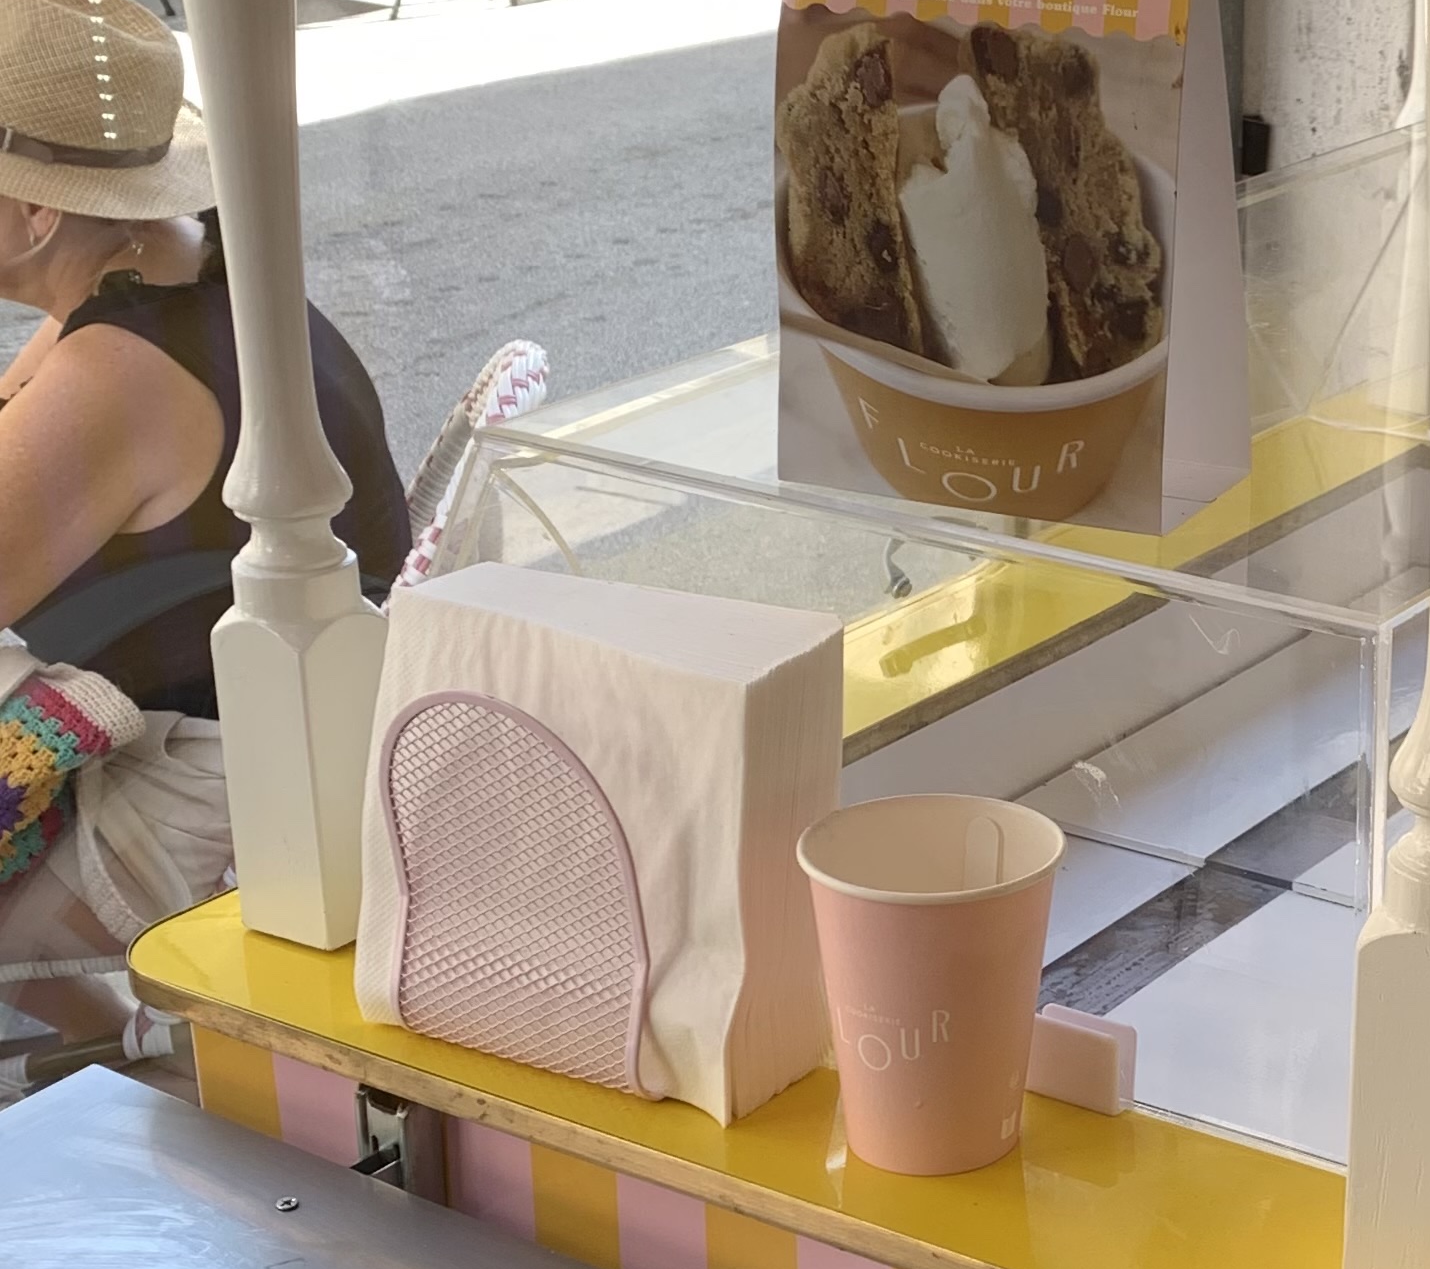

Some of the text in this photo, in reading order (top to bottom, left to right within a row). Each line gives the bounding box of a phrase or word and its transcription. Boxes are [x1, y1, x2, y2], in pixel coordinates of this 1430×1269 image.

[1036, 0, 1098, 15] boutique
[1102, 3, 1139, 18] Flour
[857, 396, 1086, 503] FLOUR
[919, 441, 1016, 467] COOKISERIE
[956, 445, 976, 455] LA
